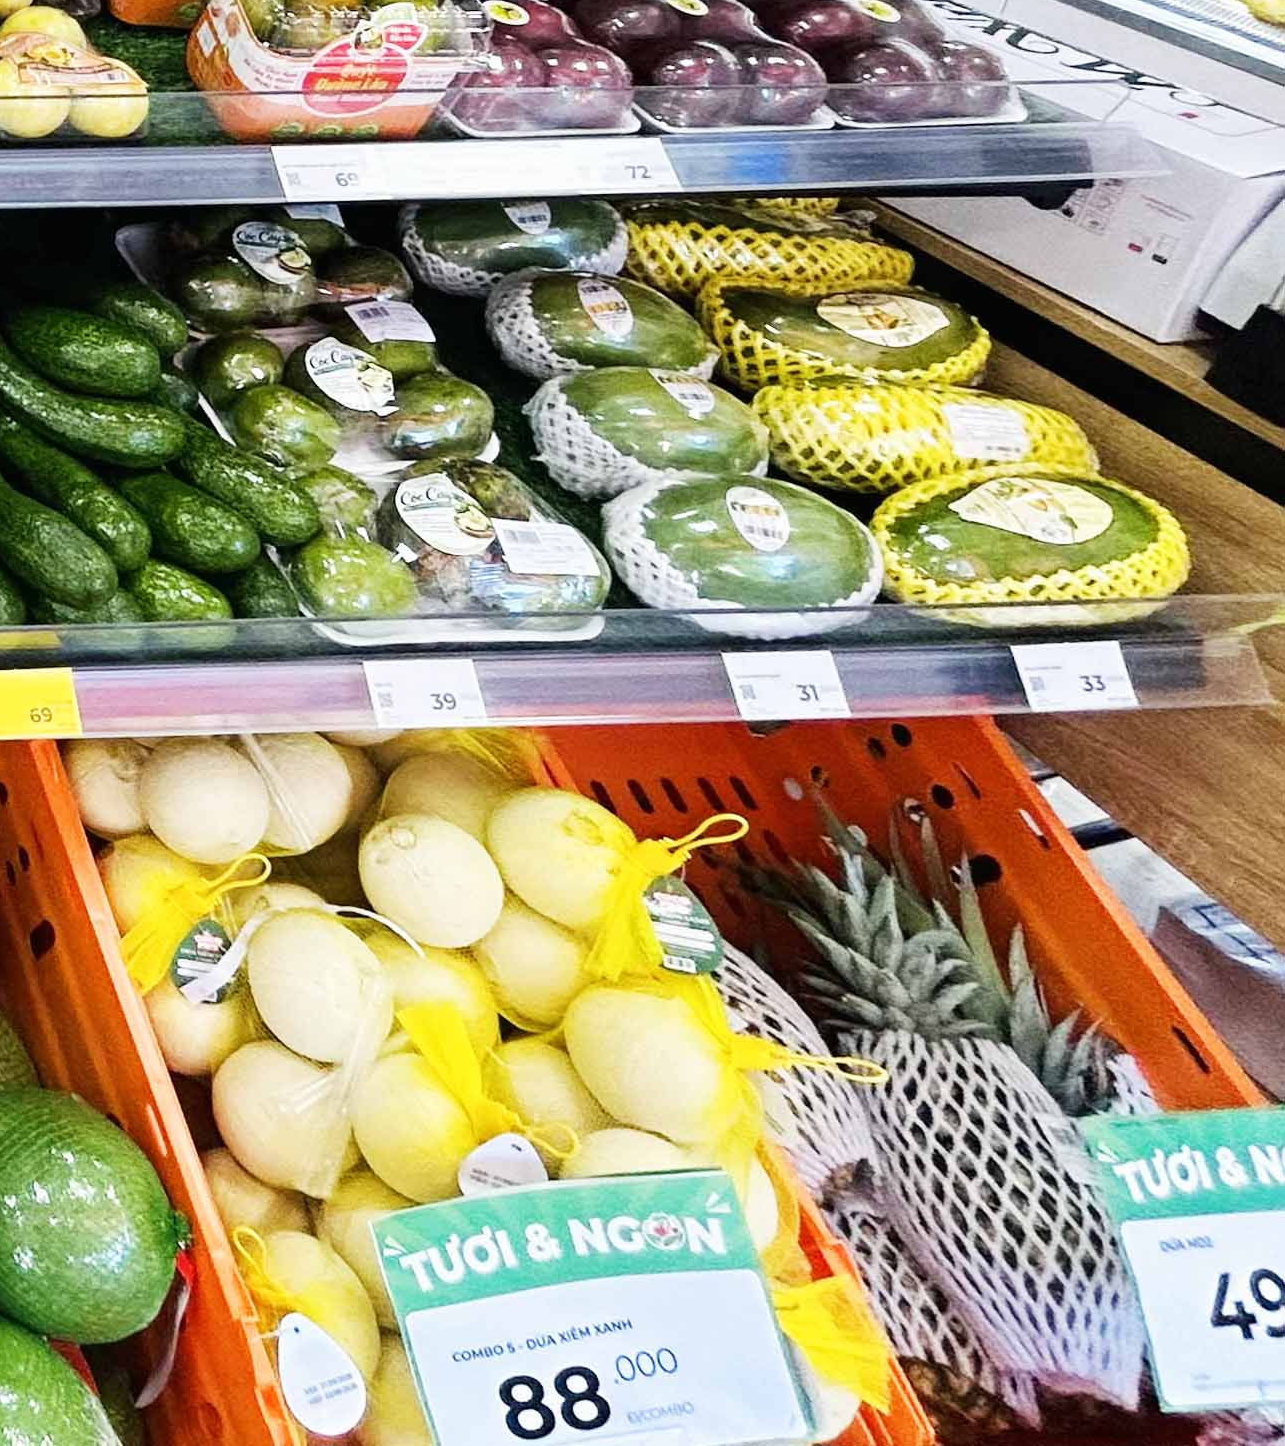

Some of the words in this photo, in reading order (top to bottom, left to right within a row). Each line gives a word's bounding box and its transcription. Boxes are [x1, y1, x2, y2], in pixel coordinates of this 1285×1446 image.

[625, 165, 652, 180] 72
[796, 684, 819, 702] 31
[1079, 675, 1106, 692] 33
[30, 707, 53, 723] 69
[430, 693, 457, 710] 39
[1111, 1144, 1214, 1203] TƯƠI
[1216, 1145, 1249, 1187] &
[399, 1225, 518, 1294] TƯƠI
[524, 1222, 562, 1263] &
[567, 1211, 726, 1255] NGON
[1210, 1267, 1285, 1341] 49
[452, 1344, 504, 1363] COMBO
[594, 1318, 634, 1336] XANH
[498, 1365, 611, 1441] 88
